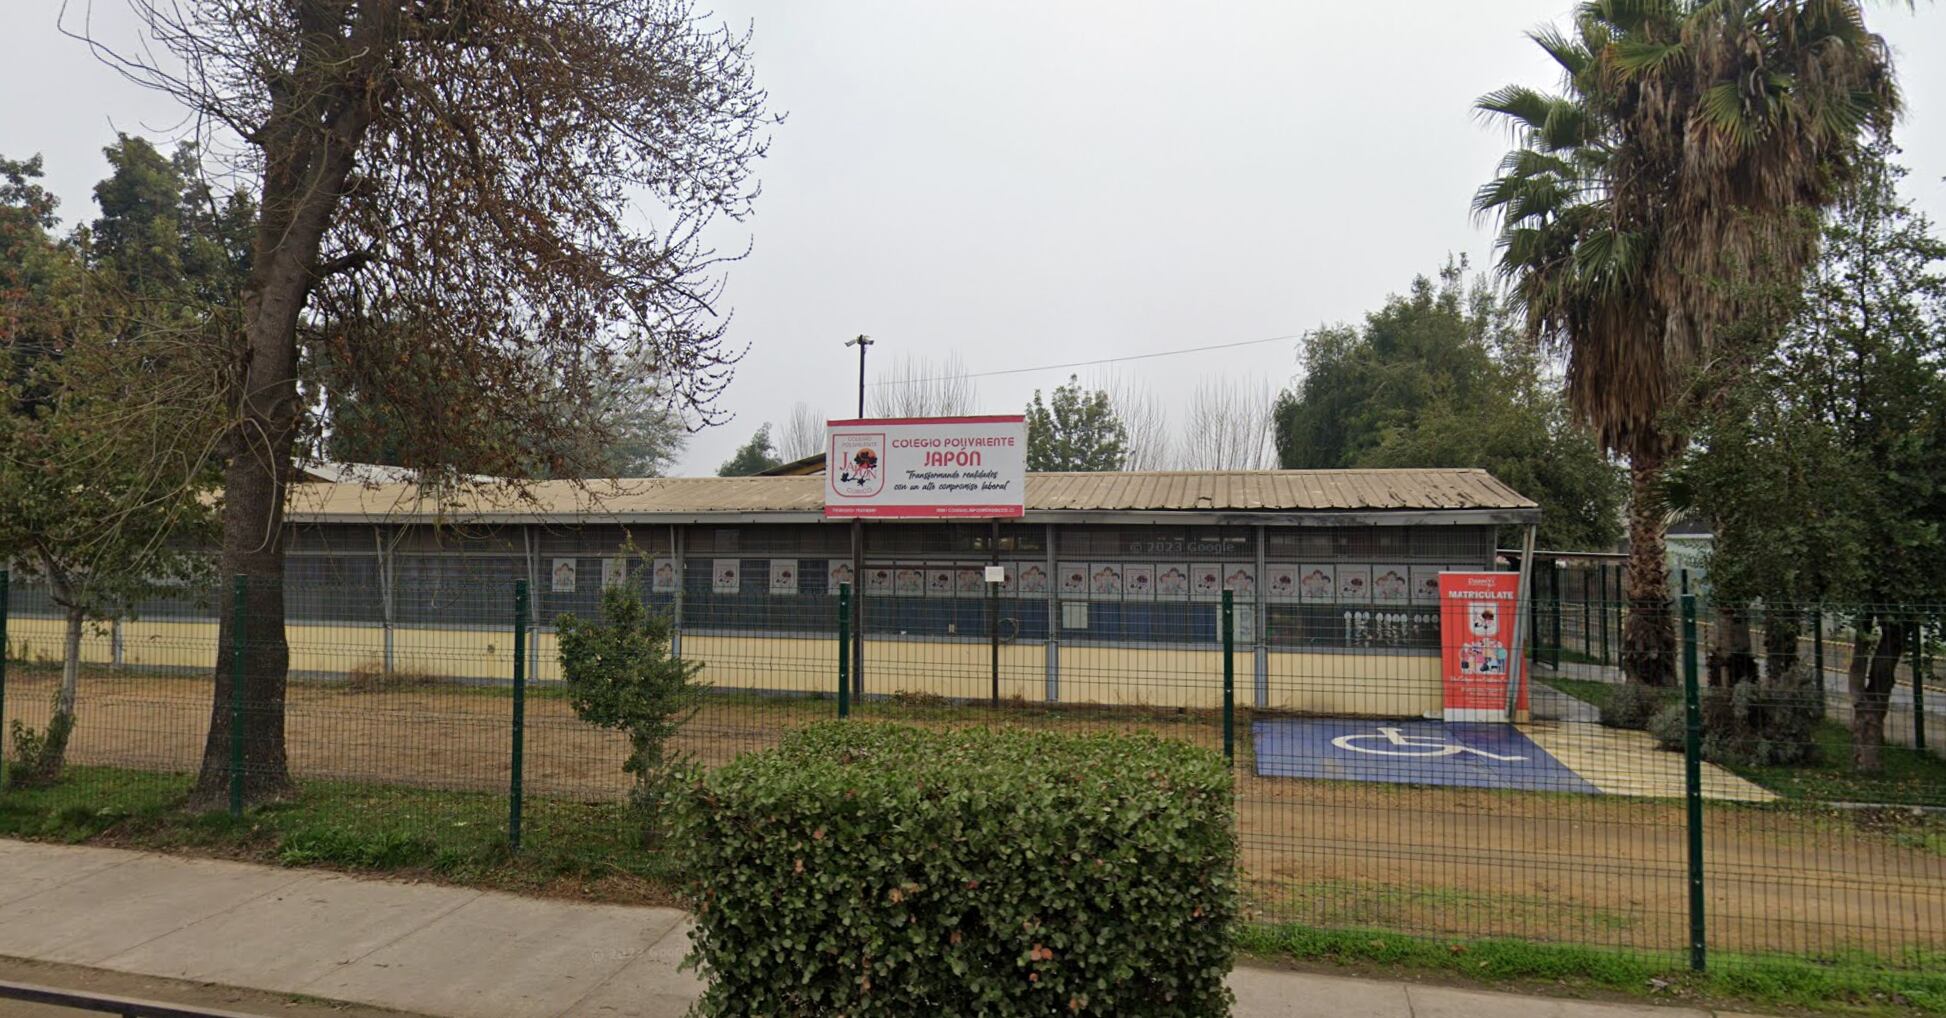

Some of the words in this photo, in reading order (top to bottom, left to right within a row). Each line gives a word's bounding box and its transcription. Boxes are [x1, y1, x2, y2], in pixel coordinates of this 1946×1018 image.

[891, 439, 941, 448] COLEGIO
[944, 437, 1015, 448] POLIVALENTE
[924, 447, 982, 467] JAPÓN
[962, 470, 999, 480] realidades
[922, 481, 936, 491] alto
[938, 482, 978, 492] compromiso
